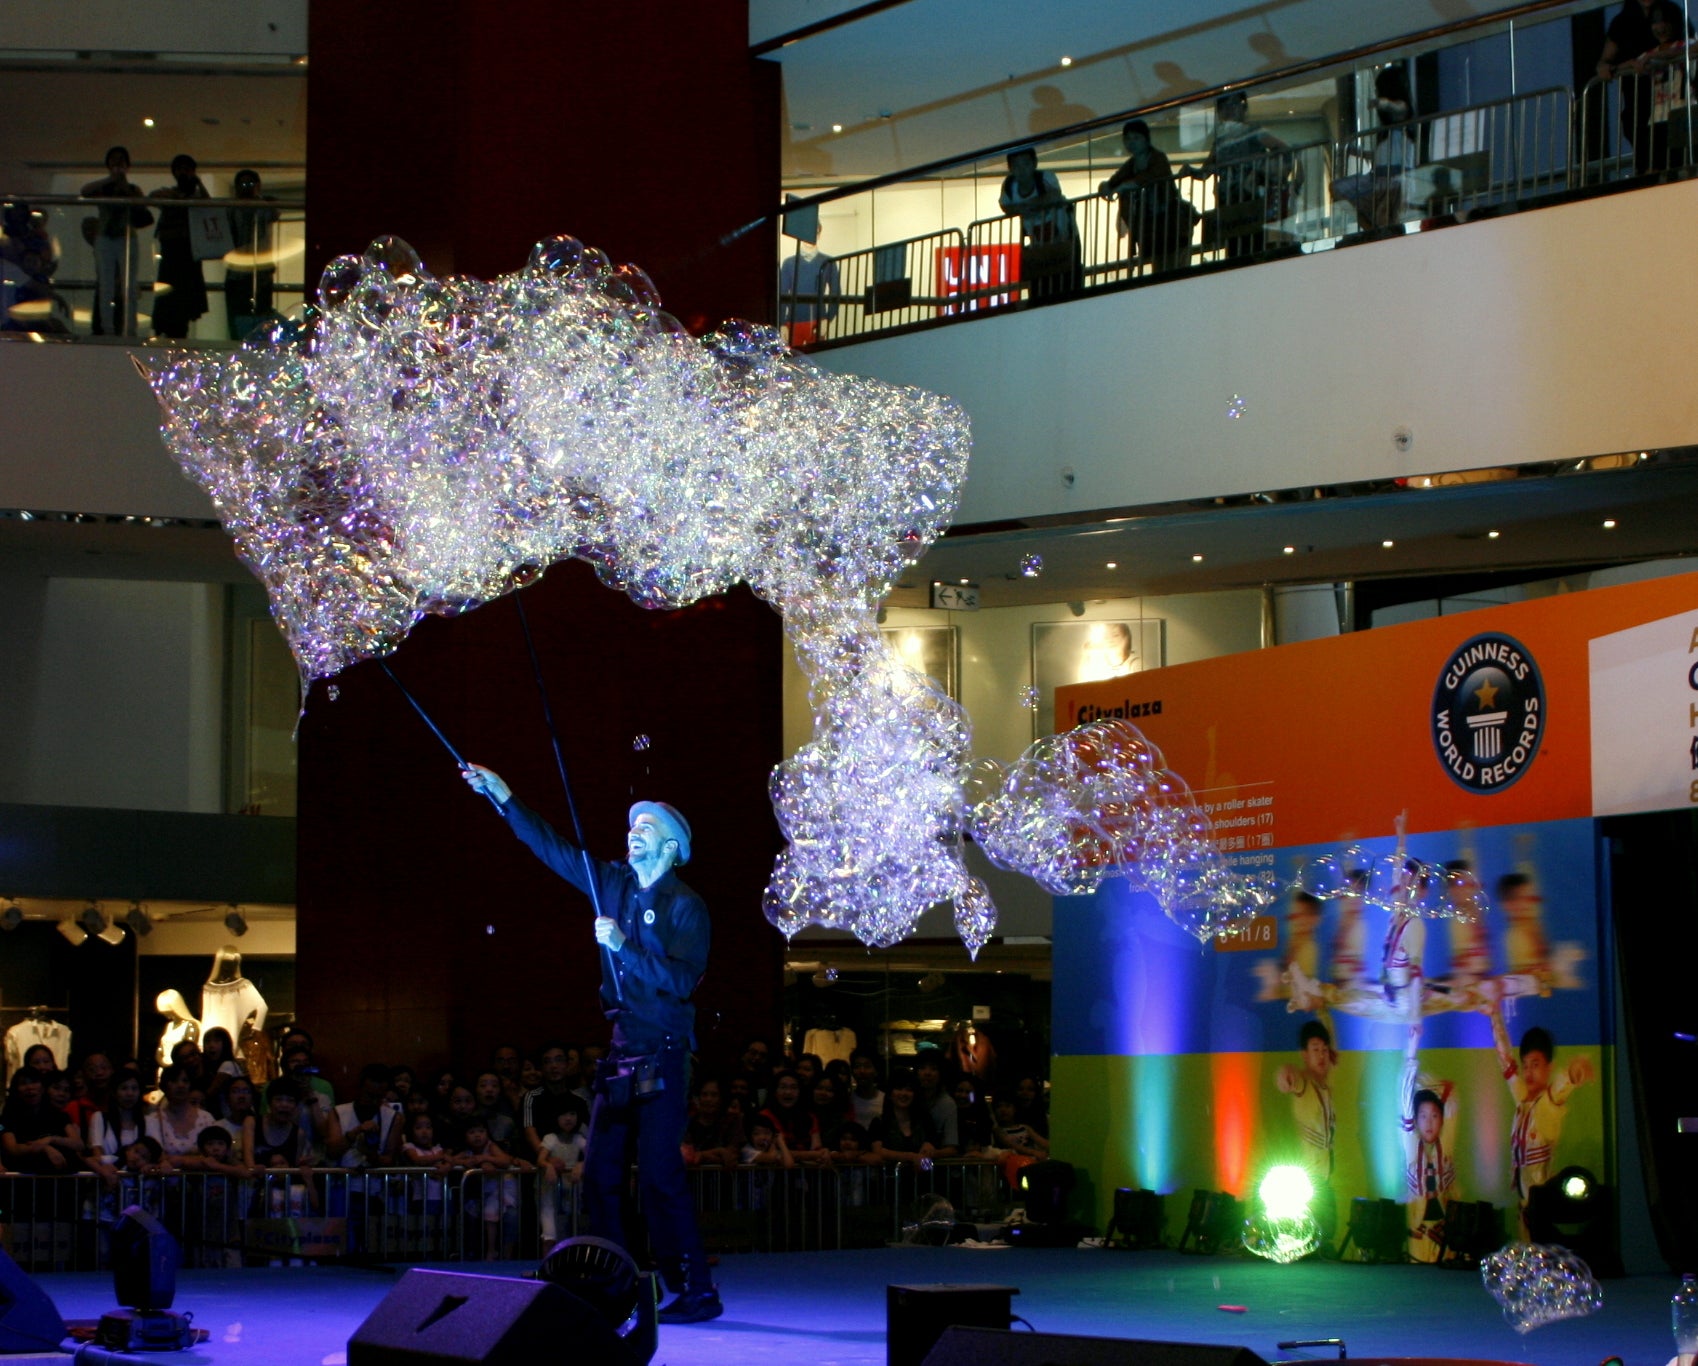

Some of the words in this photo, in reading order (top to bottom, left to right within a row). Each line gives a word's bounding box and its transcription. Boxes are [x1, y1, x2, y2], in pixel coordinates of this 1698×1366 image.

[1445, 642, 1530, 690] GUINNESS
[1436, 709, 1475, 780] WORLD
[1481, 697, 1538, 785] RECORDS
[1204, 803, 1214, 814] by
[1216, 804, 1222, 812] a
[1224, 798, 1245, 810] roller
[1247, 796, 1274, 808] skater
[1214, 815, 1256, 829] shoulders
[1257, 812, 1274, 826] (17)
[1240, 853, 1275, 867] hanging
